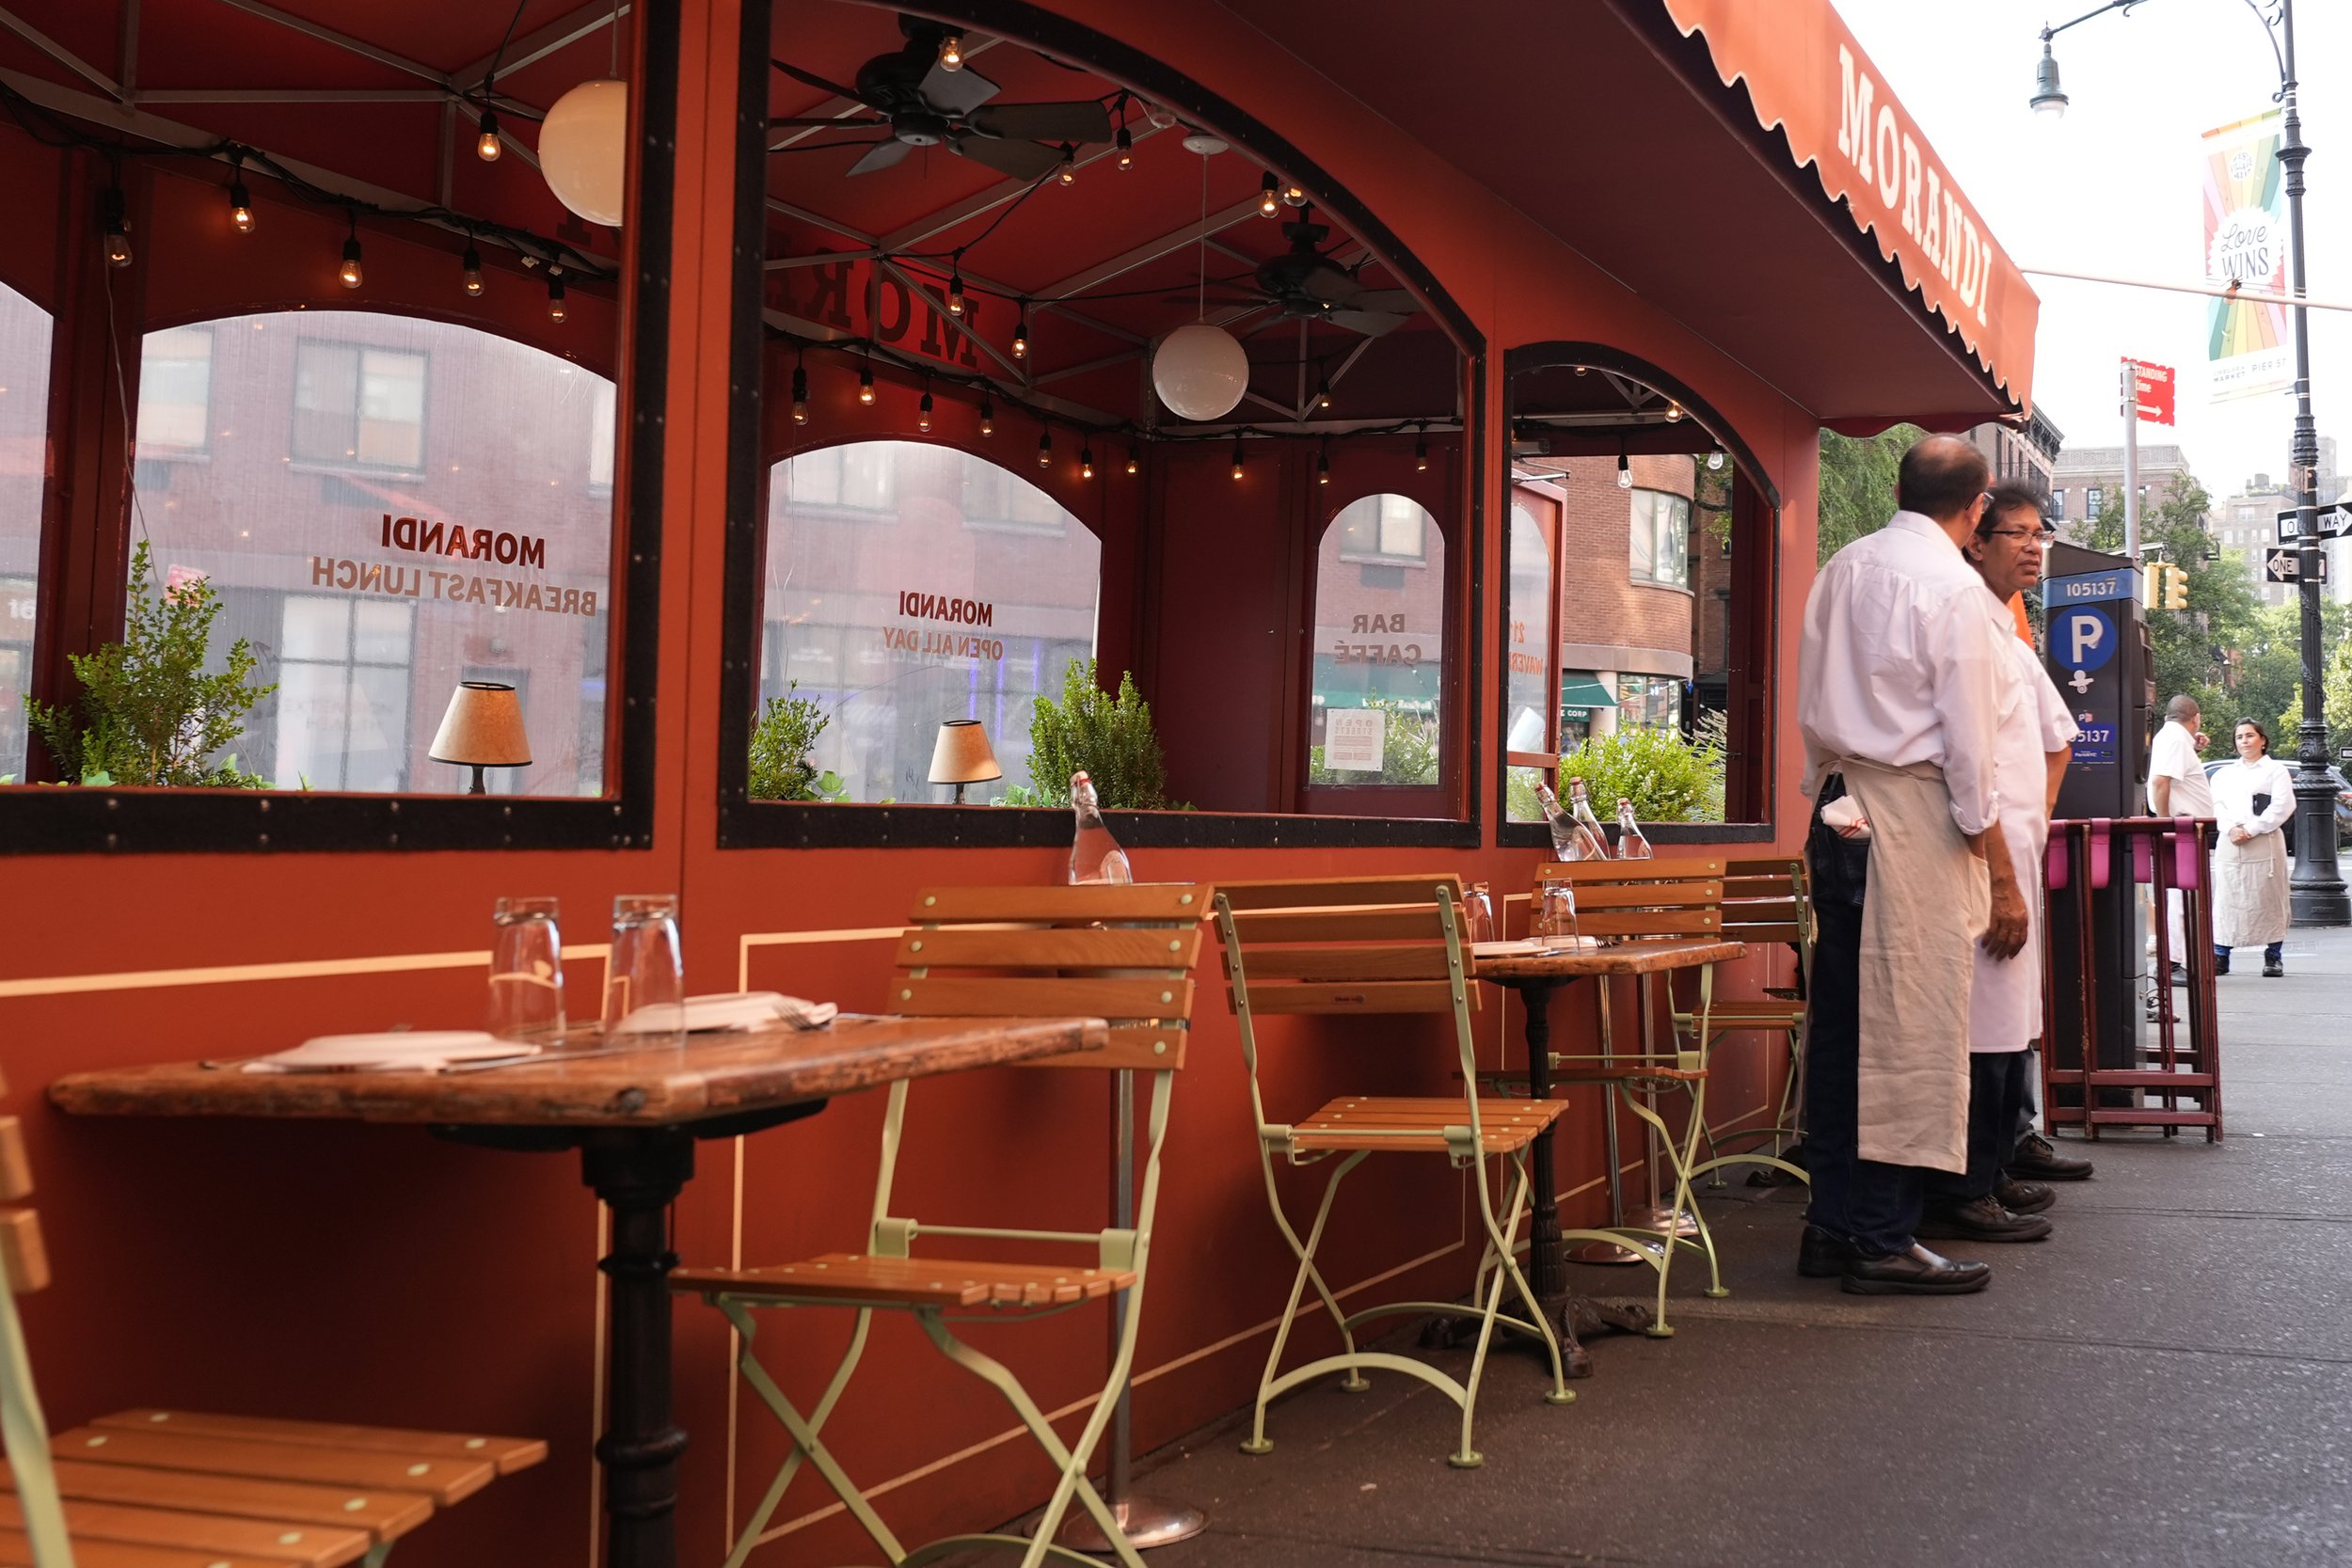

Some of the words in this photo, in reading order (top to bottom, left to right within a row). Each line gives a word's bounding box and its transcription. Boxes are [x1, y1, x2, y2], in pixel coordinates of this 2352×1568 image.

[1837, 42, 1992, 327] MORANDI
[2220, 223, 2268, 252] Love
[2222, 246, 2269, 280] WINS
[2252, 361, 2273, 372] PIER
[2323, 514, 2347, 529] WAY
[2272, 559, 2293, 573] ONE
[2066, 580, 2116, 597] 105137
[2071, 615, 2104, 663] P
[1566, 709, 1587, 718] CORP
[2070, 730, 2109, 742] 5137
